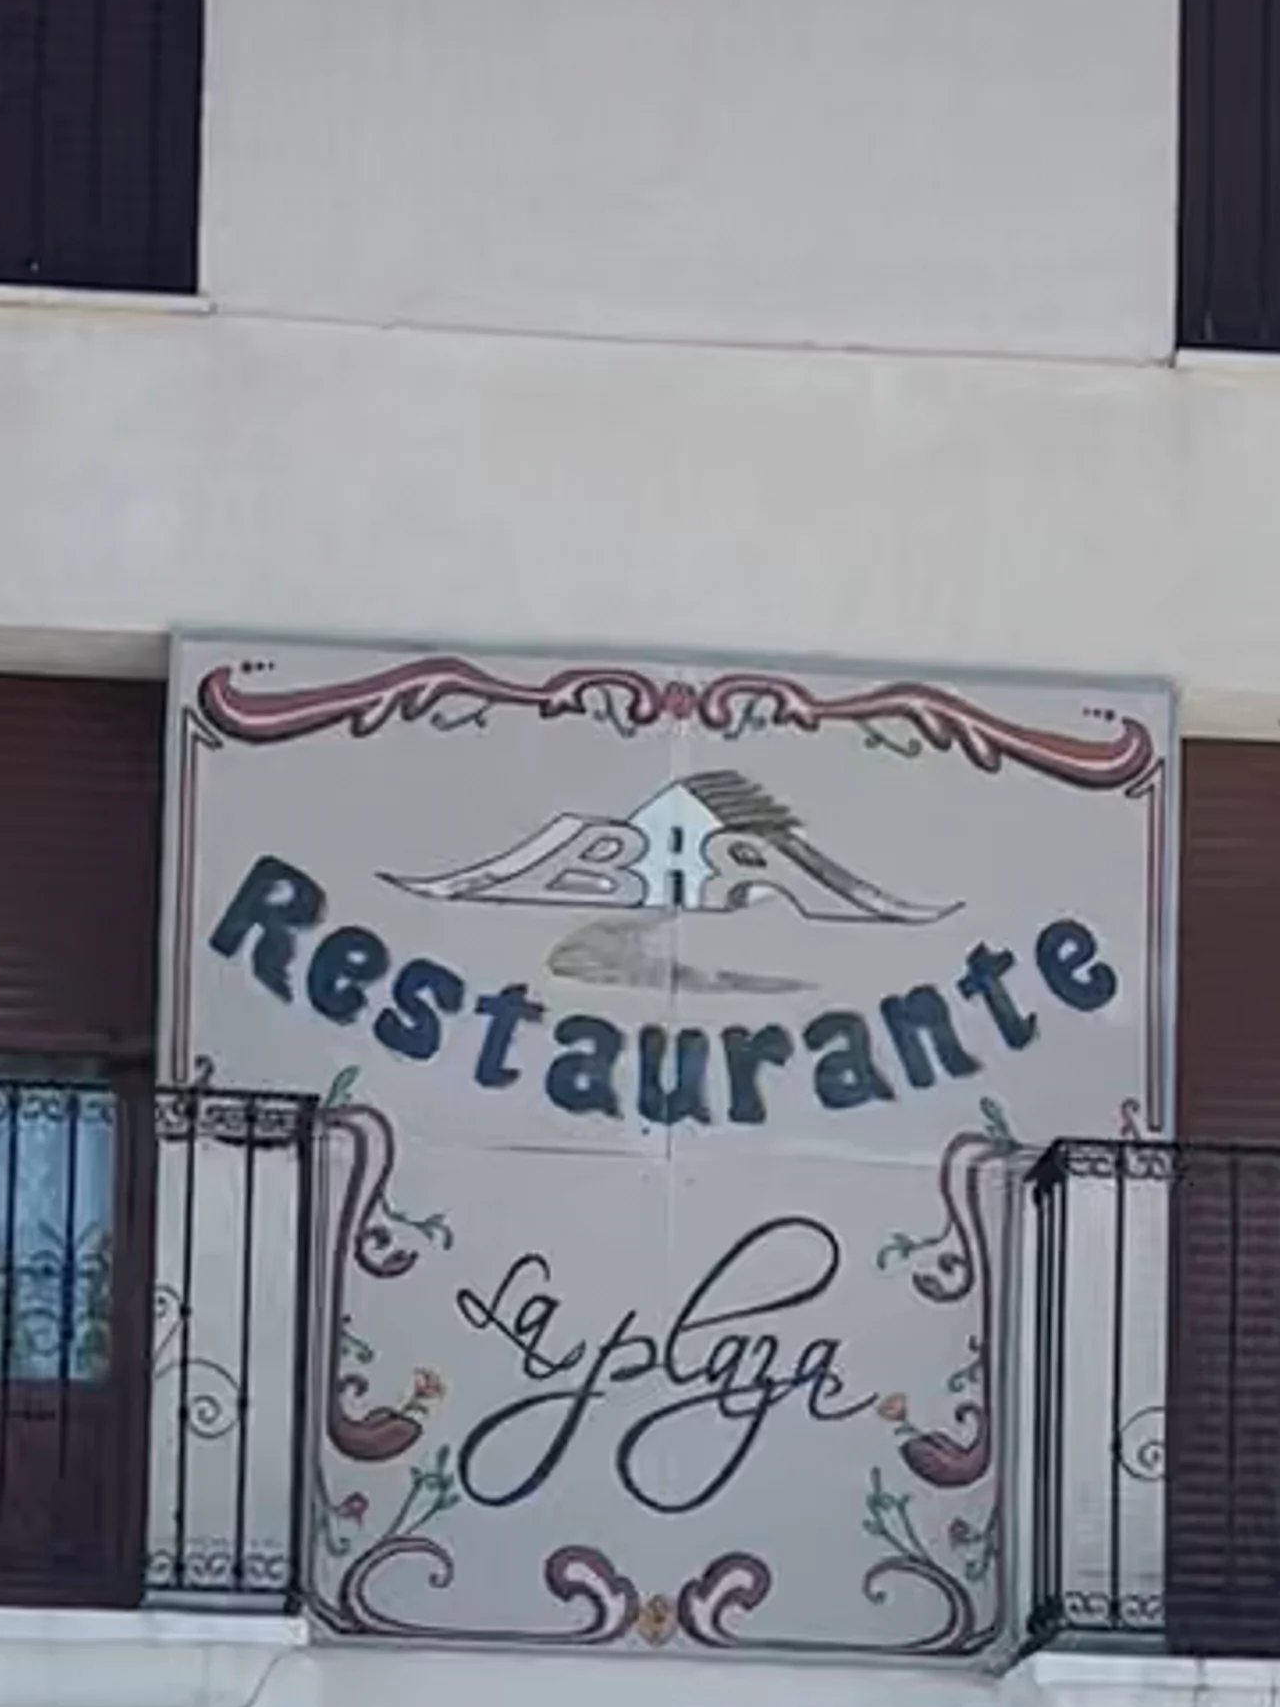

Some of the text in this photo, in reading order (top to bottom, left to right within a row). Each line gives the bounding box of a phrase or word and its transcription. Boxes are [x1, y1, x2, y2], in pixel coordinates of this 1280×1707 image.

[209, 854, 1119, 1127] Restaurante
[456, 1216, 879, 1514] La plaza
